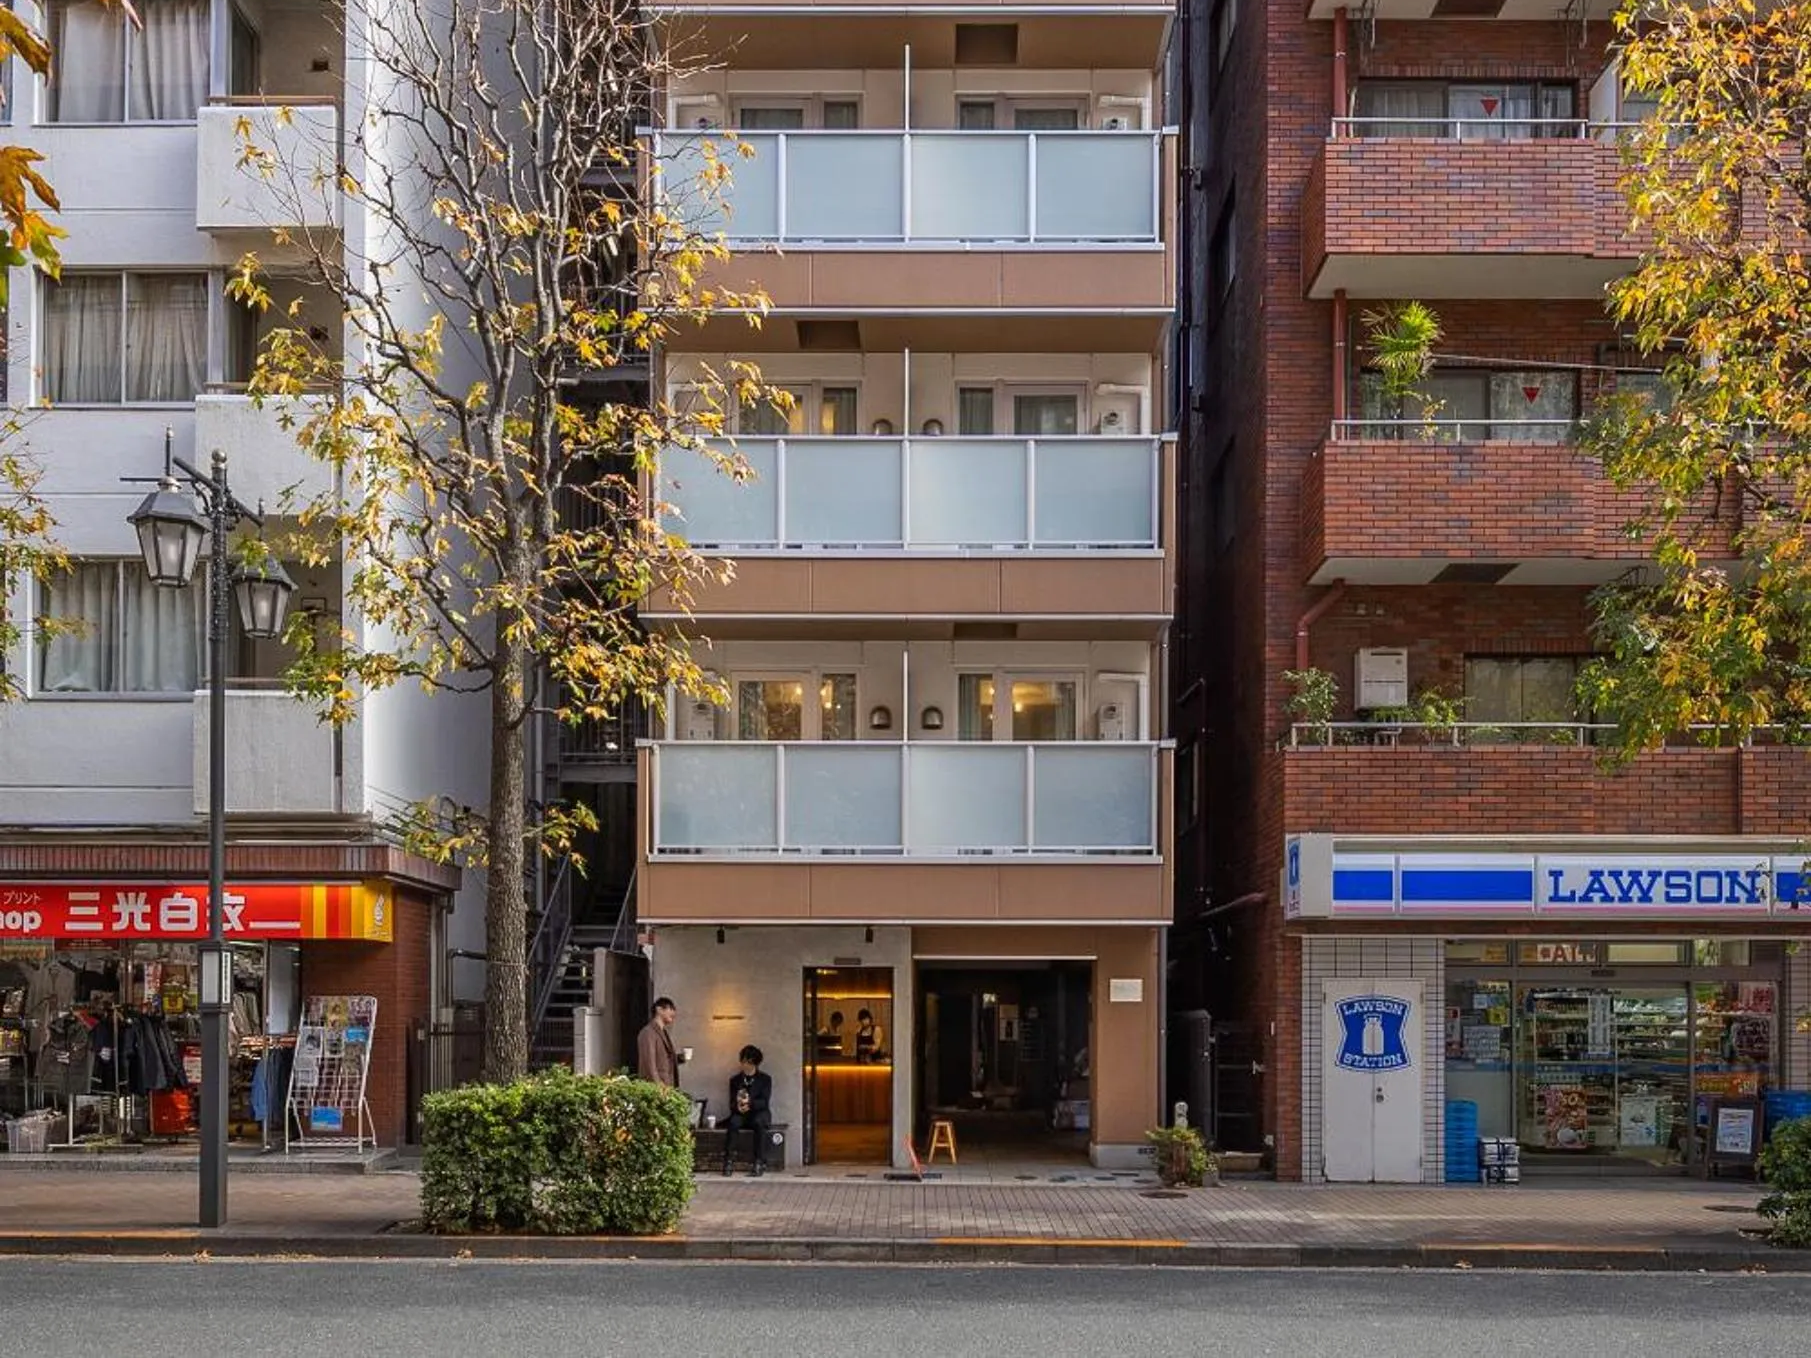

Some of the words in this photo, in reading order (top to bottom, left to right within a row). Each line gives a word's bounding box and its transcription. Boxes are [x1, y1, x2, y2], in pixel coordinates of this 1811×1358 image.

[1547, 869, 1765, 904] LAWSON
[3, 890, 41, 905] プリント
[0, 910, 43, 934] op
[1342, 1001, 1404, 1016] LAWSON
[1342, 1052, 1403, 1068] STATION
